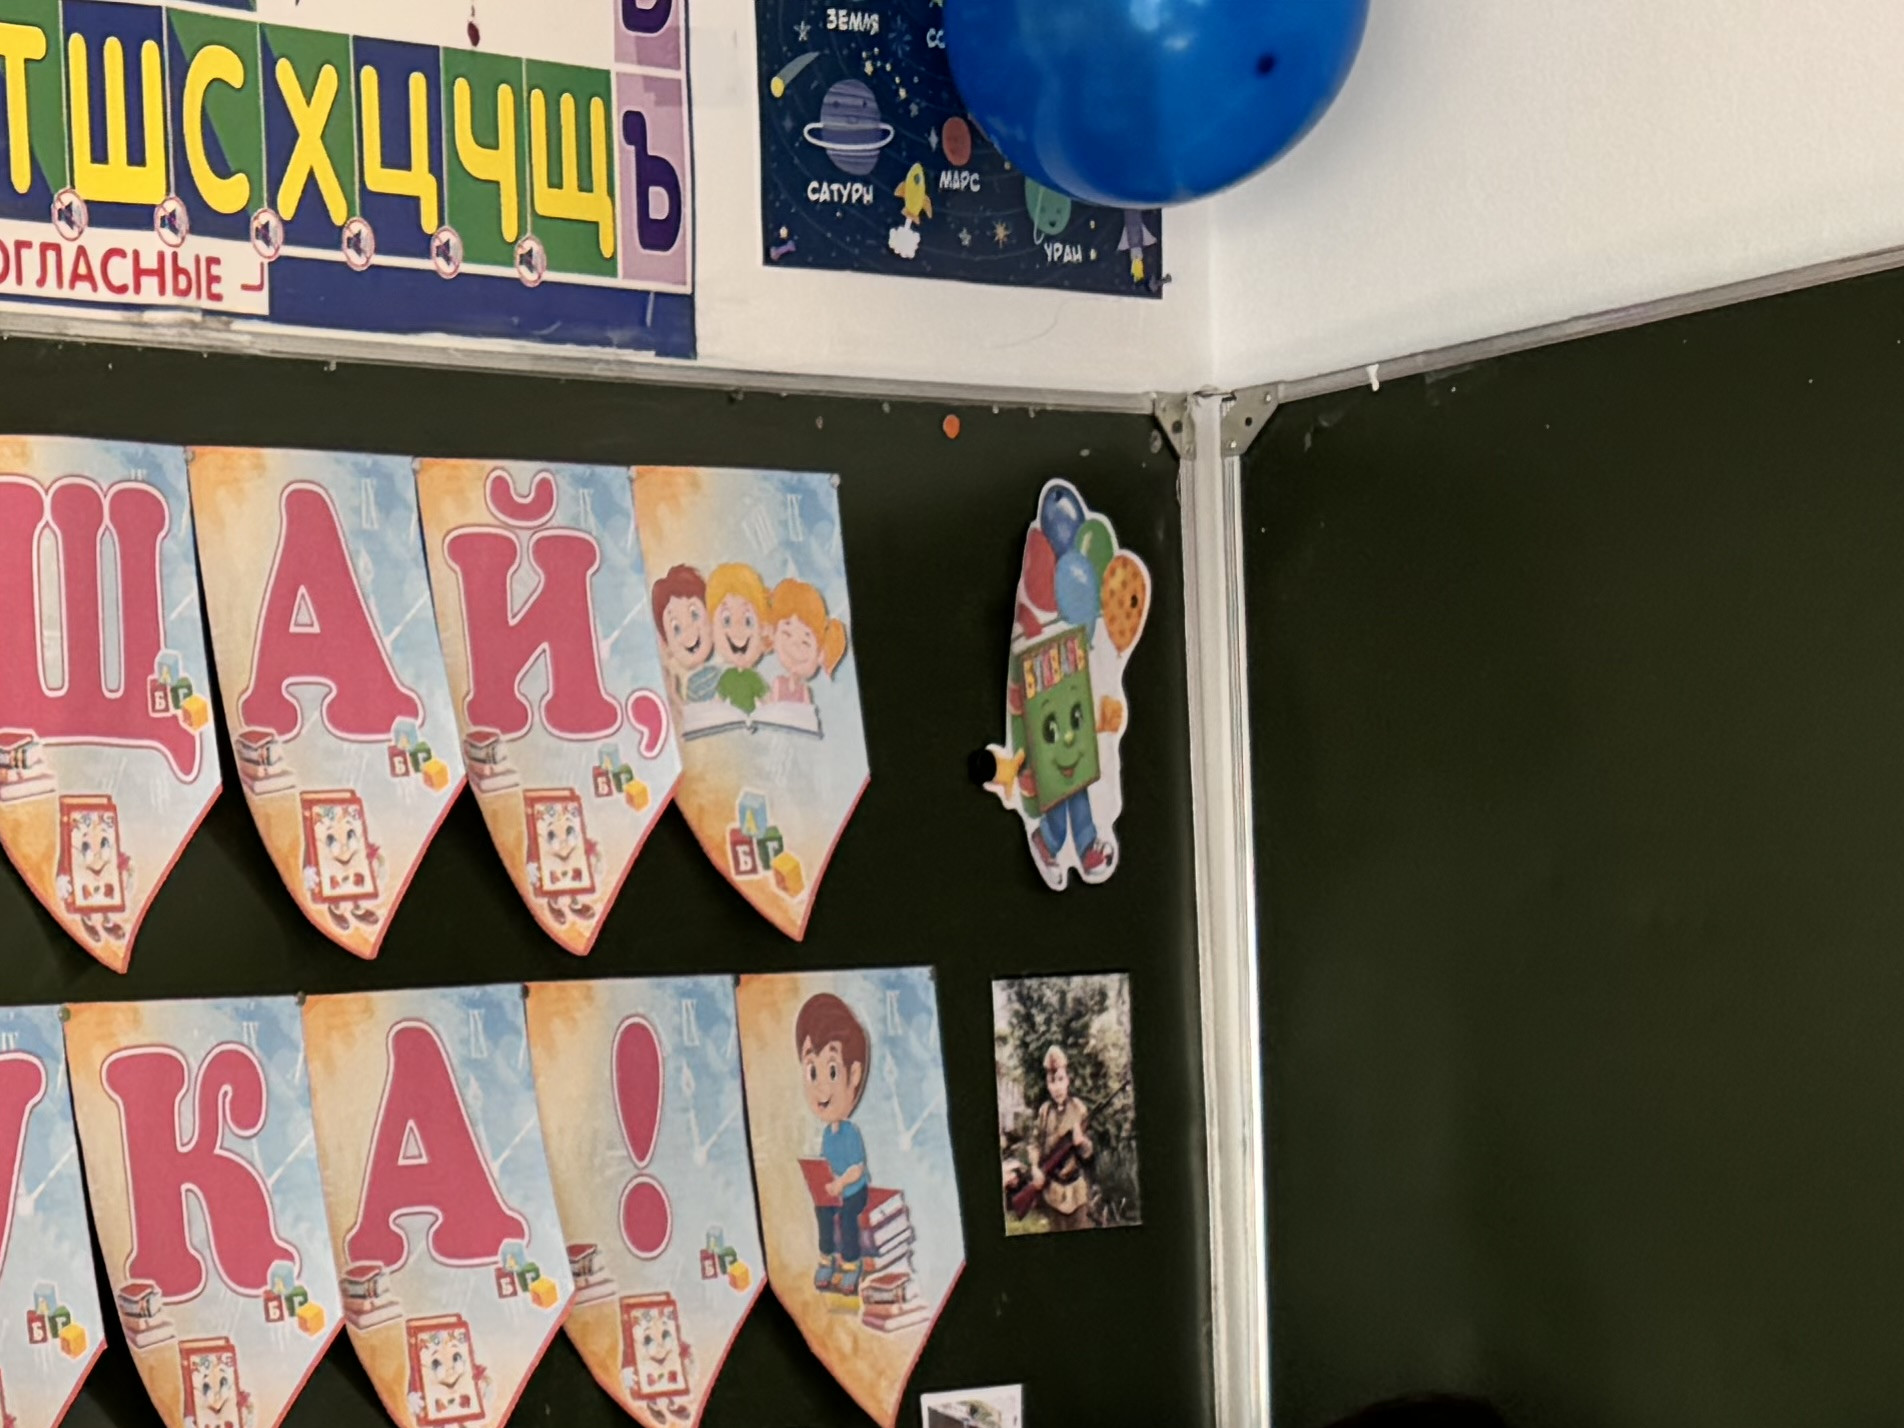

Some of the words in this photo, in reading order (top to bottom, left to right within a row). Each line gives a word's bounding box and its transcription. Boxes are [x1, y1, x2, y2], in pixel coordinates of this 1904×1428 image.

[825, 8, 880, 34] ЗЕМЛЯ
[621, 109, 682, 252] Ъ
[807, 180, 874, 204] САТУРН
[939, 169, 981, 192] МАРС
[1044, 242, 1083, 263] УРАН
[735, 844, 753, 871] Б
